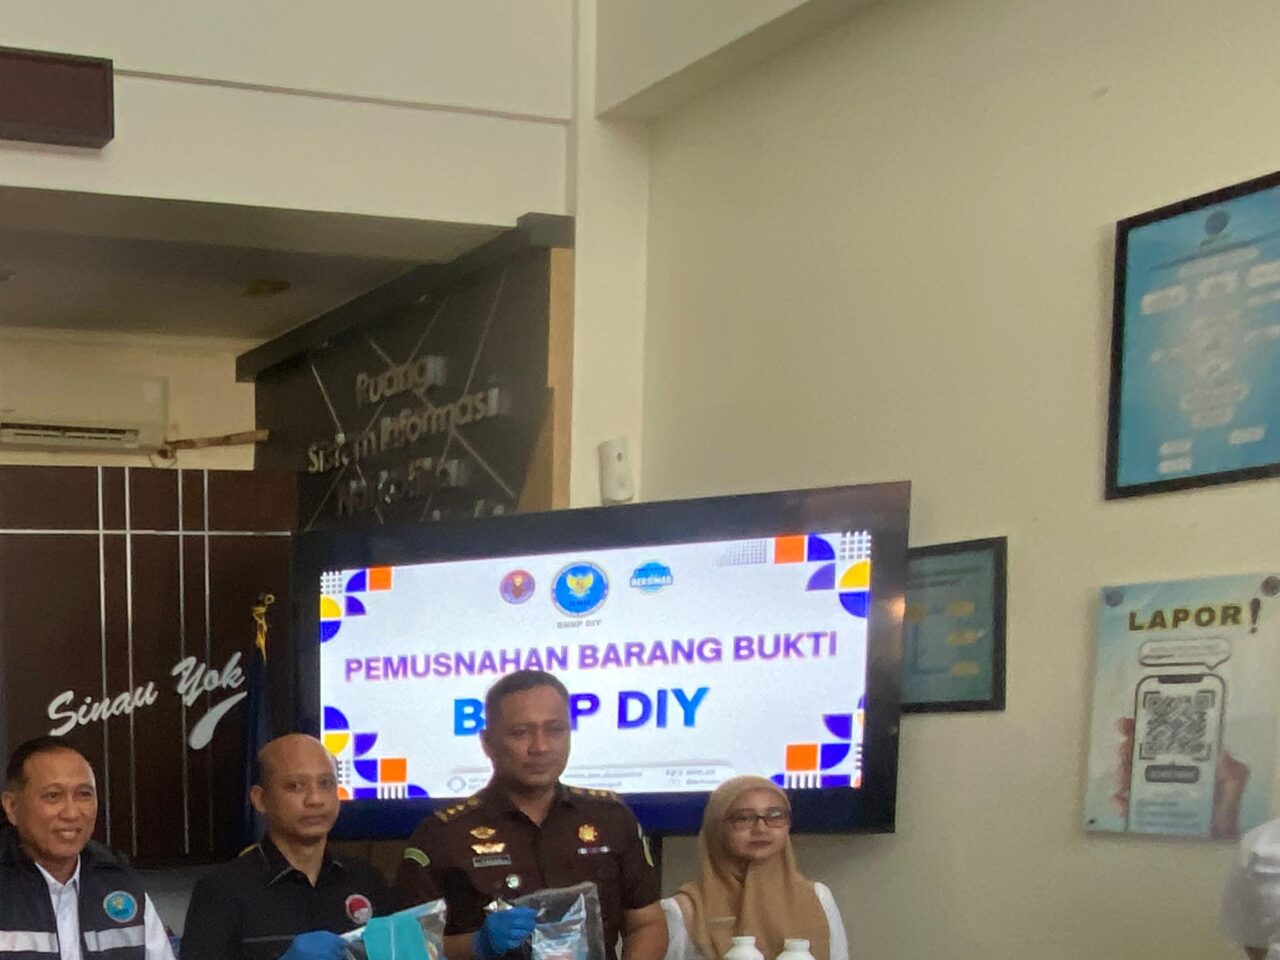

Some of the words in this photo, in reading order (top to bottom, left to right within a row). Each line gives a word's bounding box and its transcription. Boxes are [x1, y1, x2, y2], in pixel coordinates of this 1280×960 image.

[344, 645, 569, 682] PEMUSNAHAN
[578, 637, 722, 669] BARANG
[733, 631, 838, 661] BUKTI
[48, 681, 158, 737] Sinau
[171, 651, 246, 707] Yok
[453, 692, 600, 736] BP
[617, 686, 711, 730] DIY
